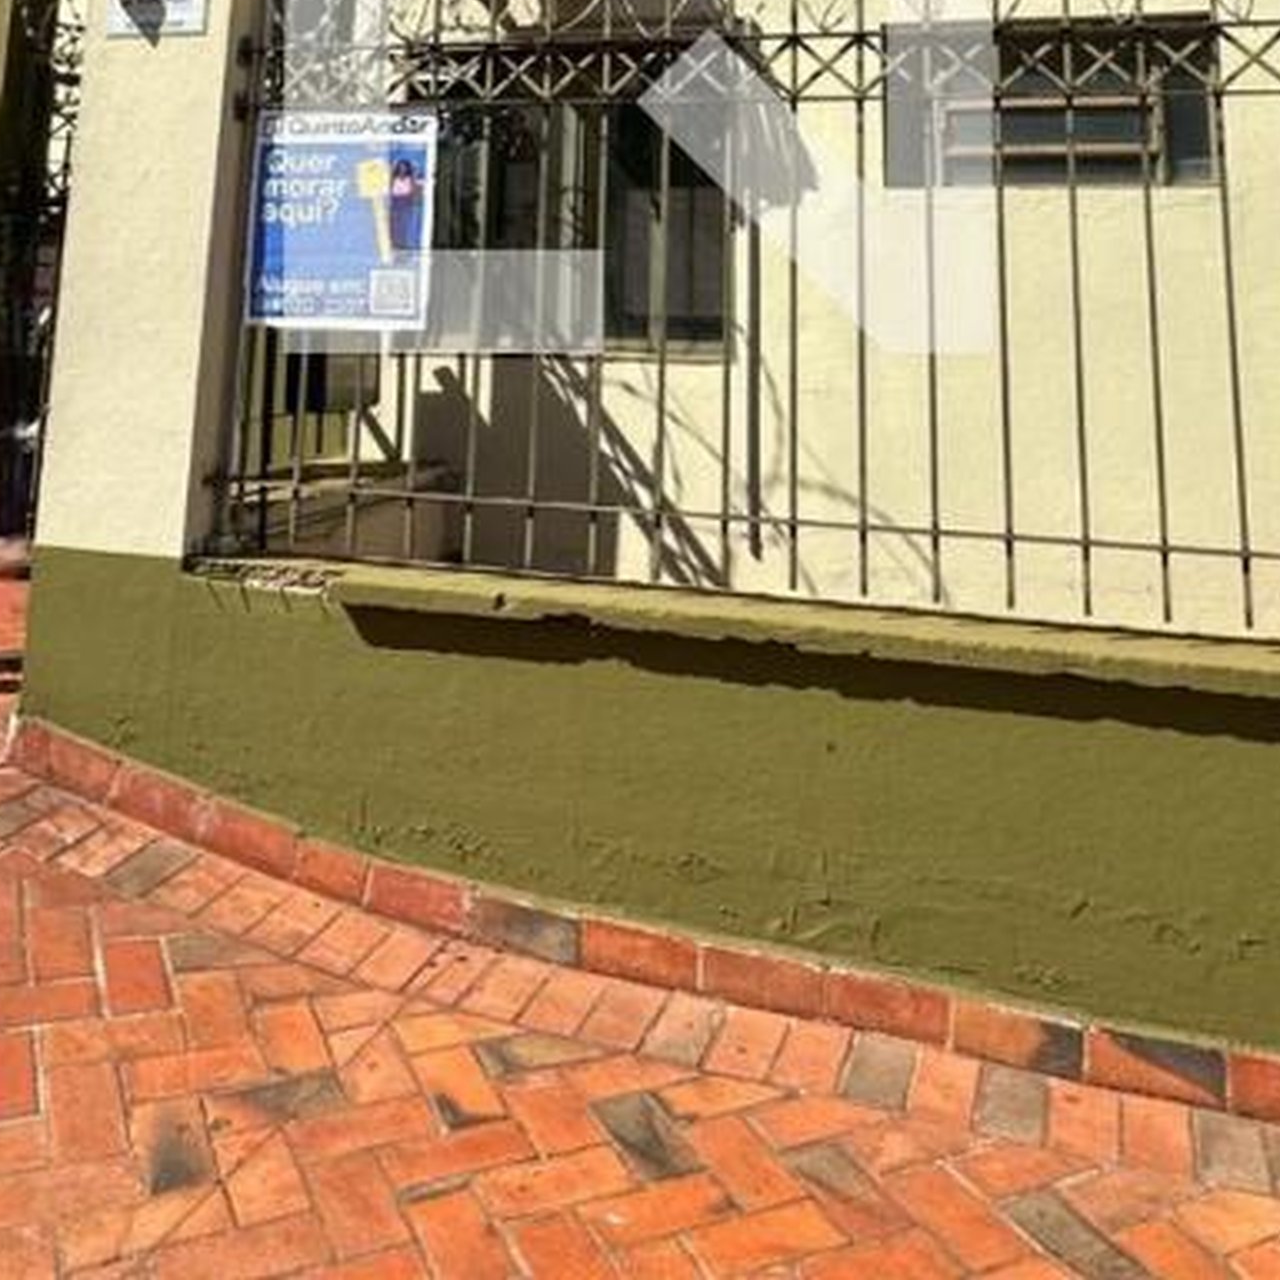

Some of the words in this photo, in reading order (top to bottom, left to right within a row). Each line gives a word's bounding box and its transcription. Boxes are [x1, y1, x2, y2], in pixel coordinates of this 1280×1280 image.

[266, 147, 338, 173] Quer
[262, 178, 347, 199] morar
[262, 198, 341, 227] aqui?
